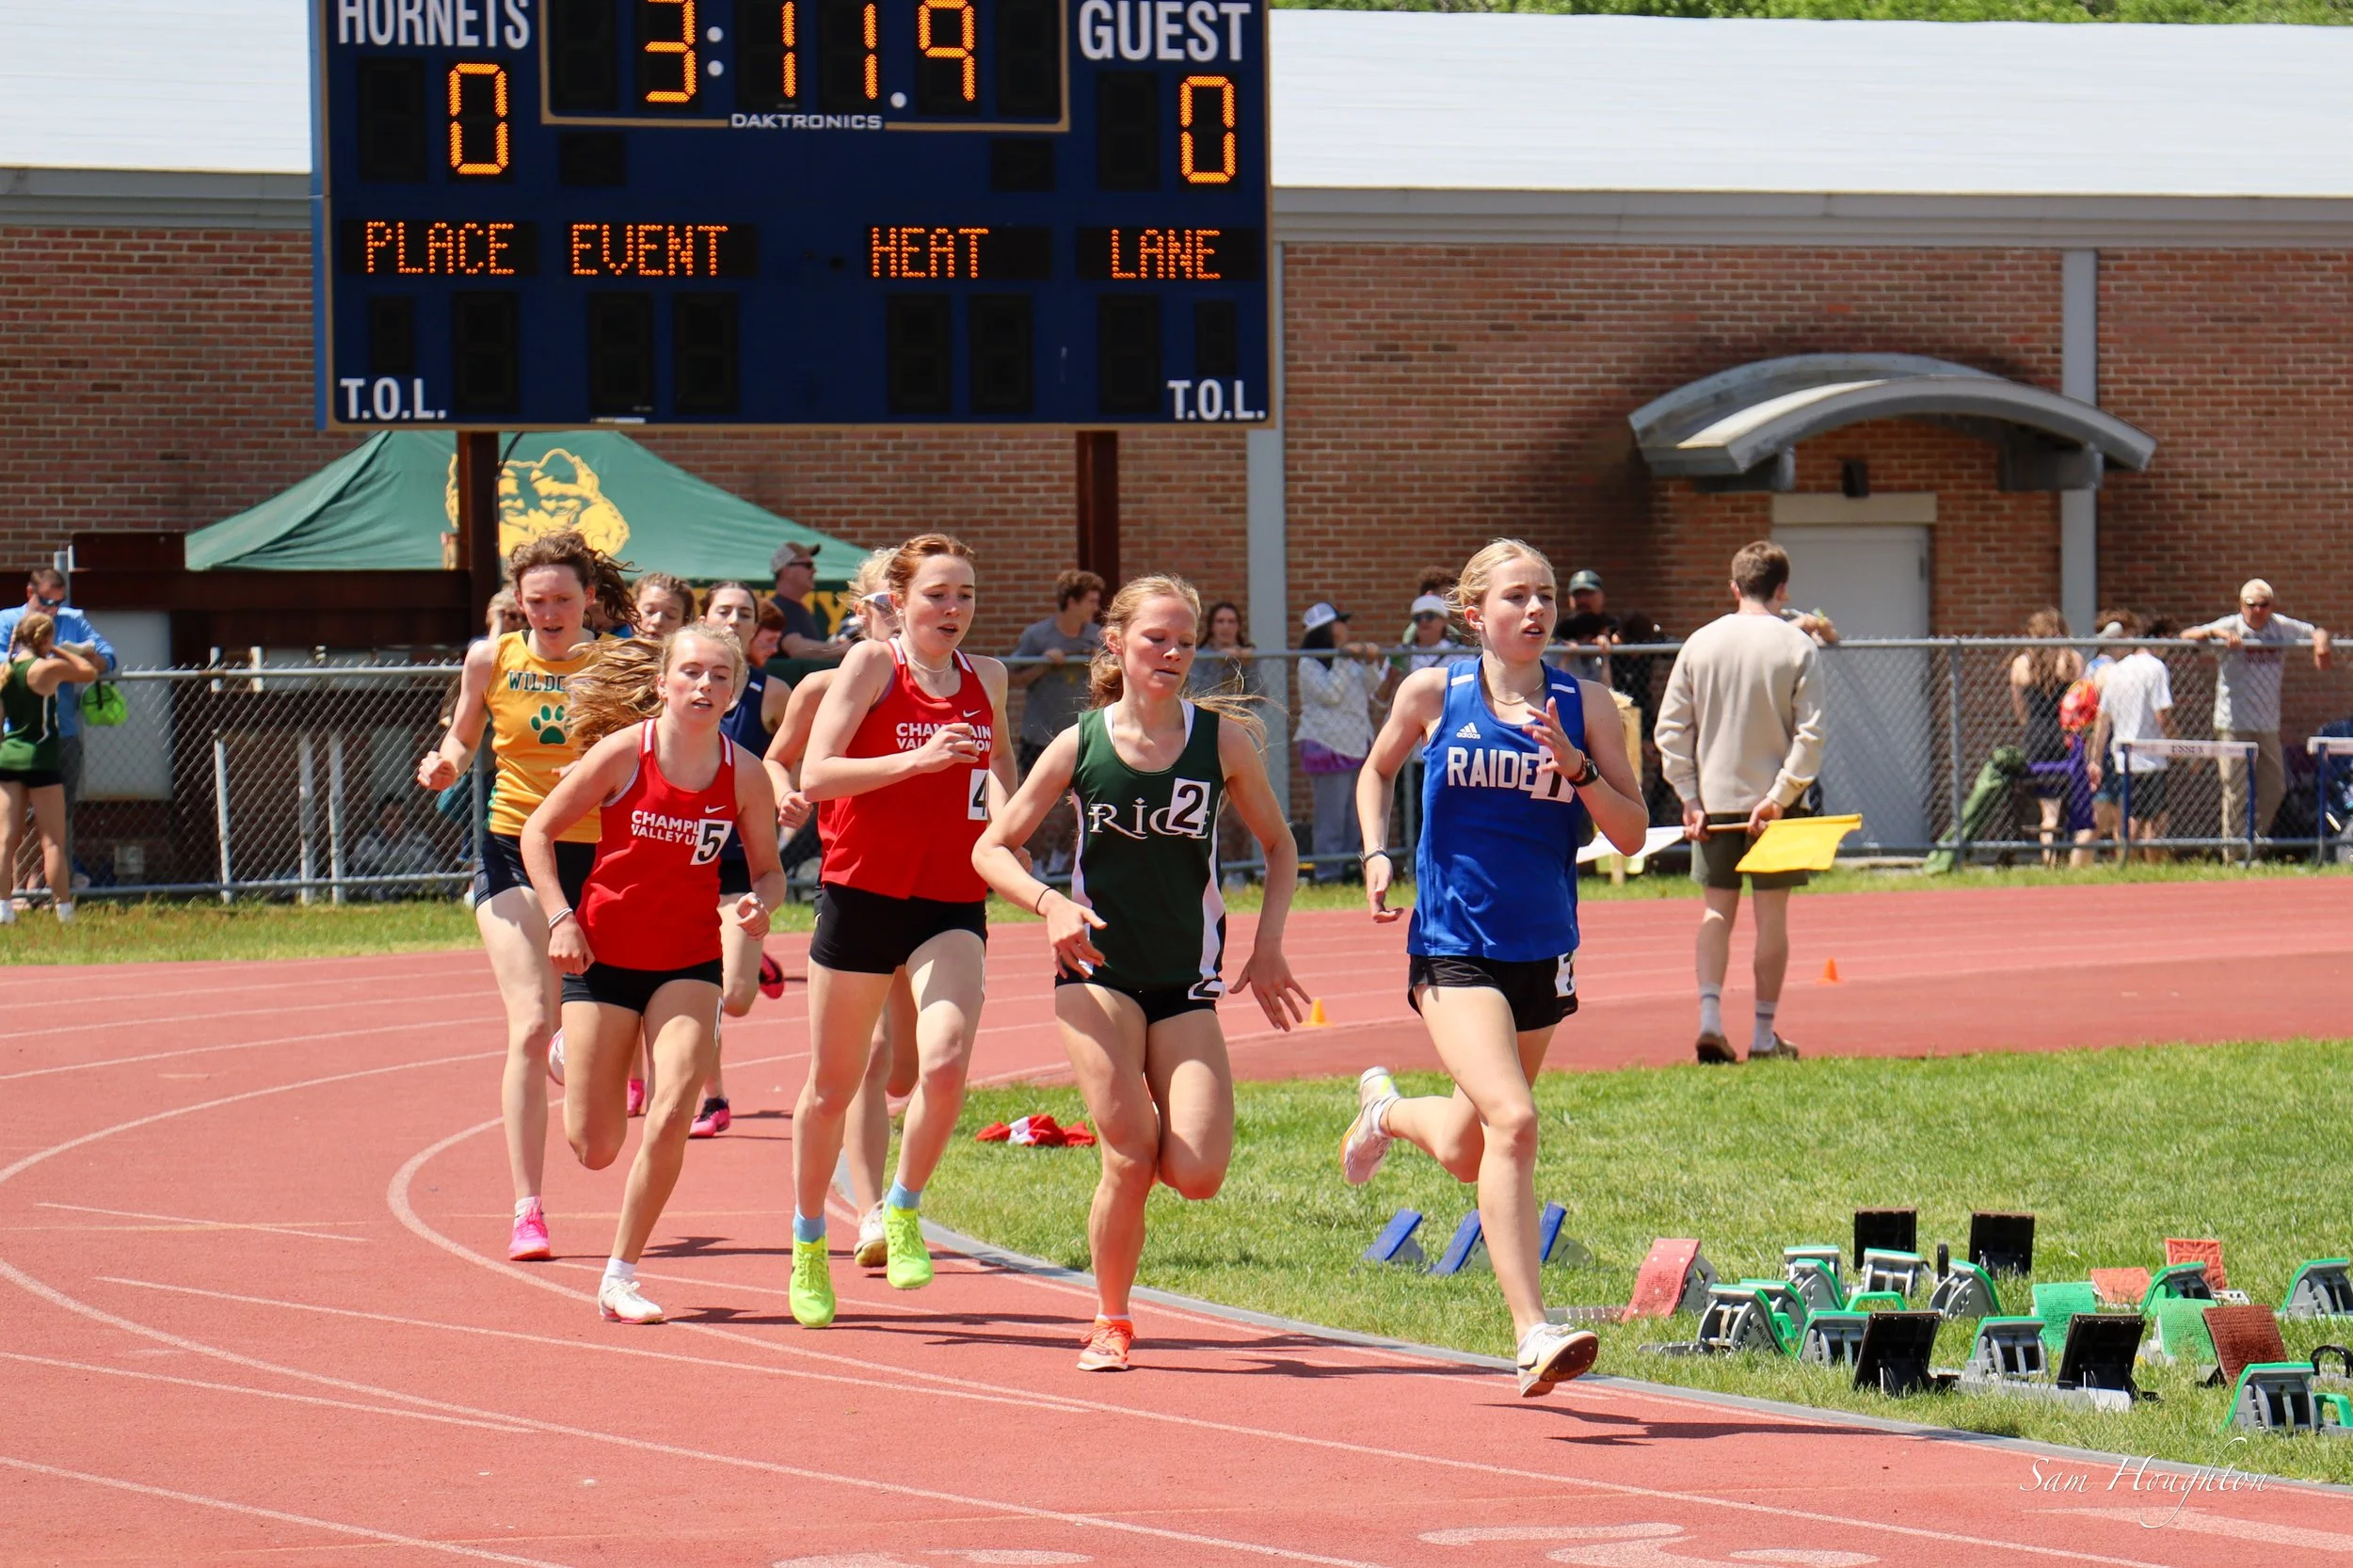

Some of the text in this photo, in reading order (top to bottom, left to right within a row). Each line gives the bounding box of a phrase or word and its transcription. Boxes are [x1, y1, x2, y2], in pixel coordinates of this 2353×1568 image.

[337, 0, 531, 49] HORNETS
[1079, 0, 1251, 61] GUEST
[448, 62, 509, 175] 0
[730, 113, 883, 130] DAKTRONICS
[1179, 75, 1236, 184] 0
[365, 221, 515, 274] PLACE
[571, 224, 728, 276] EVENT
[871, 227, 989, 279] HEAT
[1112, 228, 1222, 280] LANE
[340, 377, 447, 420] T.O.L.
[1167, 379, 1266, 421] T.O.L.
[508, 670, 567, 693] WILDC
[1456, 730, 1481, 740] adidas
[1448, 746, 1540, 792] RAIDE
[1171, 783, 1204, 830] 2
[697, 823, 725, 862] 5
